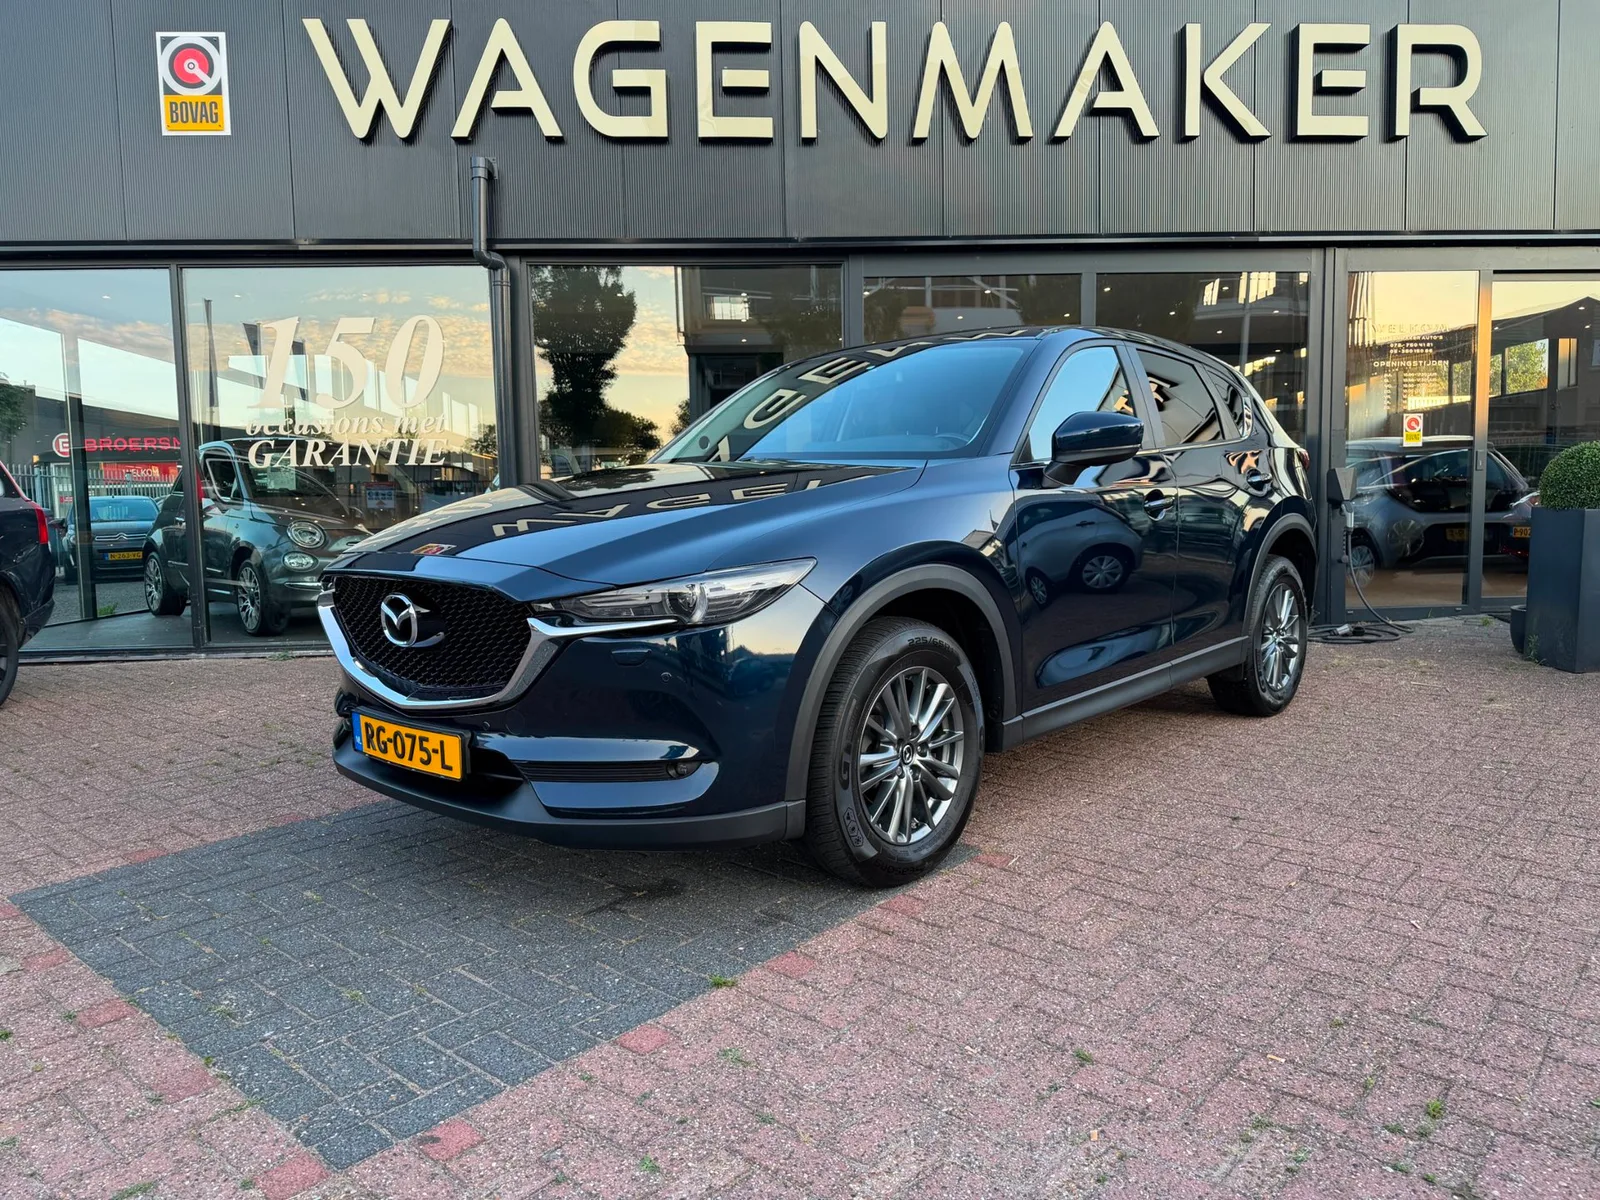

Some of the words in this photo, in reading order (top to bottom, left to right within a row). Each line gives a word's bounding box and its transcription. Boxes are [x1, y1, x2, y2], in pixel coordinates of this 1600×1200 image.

[303, 18, 1488, 140] WAGENMAKER
[169, 101, 219, 124] BOVAG
[247, 315, 444, 409] 150
[245, 415, 384, 436] occasions
[393, 412, 447, 435] met
[248, 437, 451, 468] GARANTIE
[364, 721, 453, 771] RG-075-L
